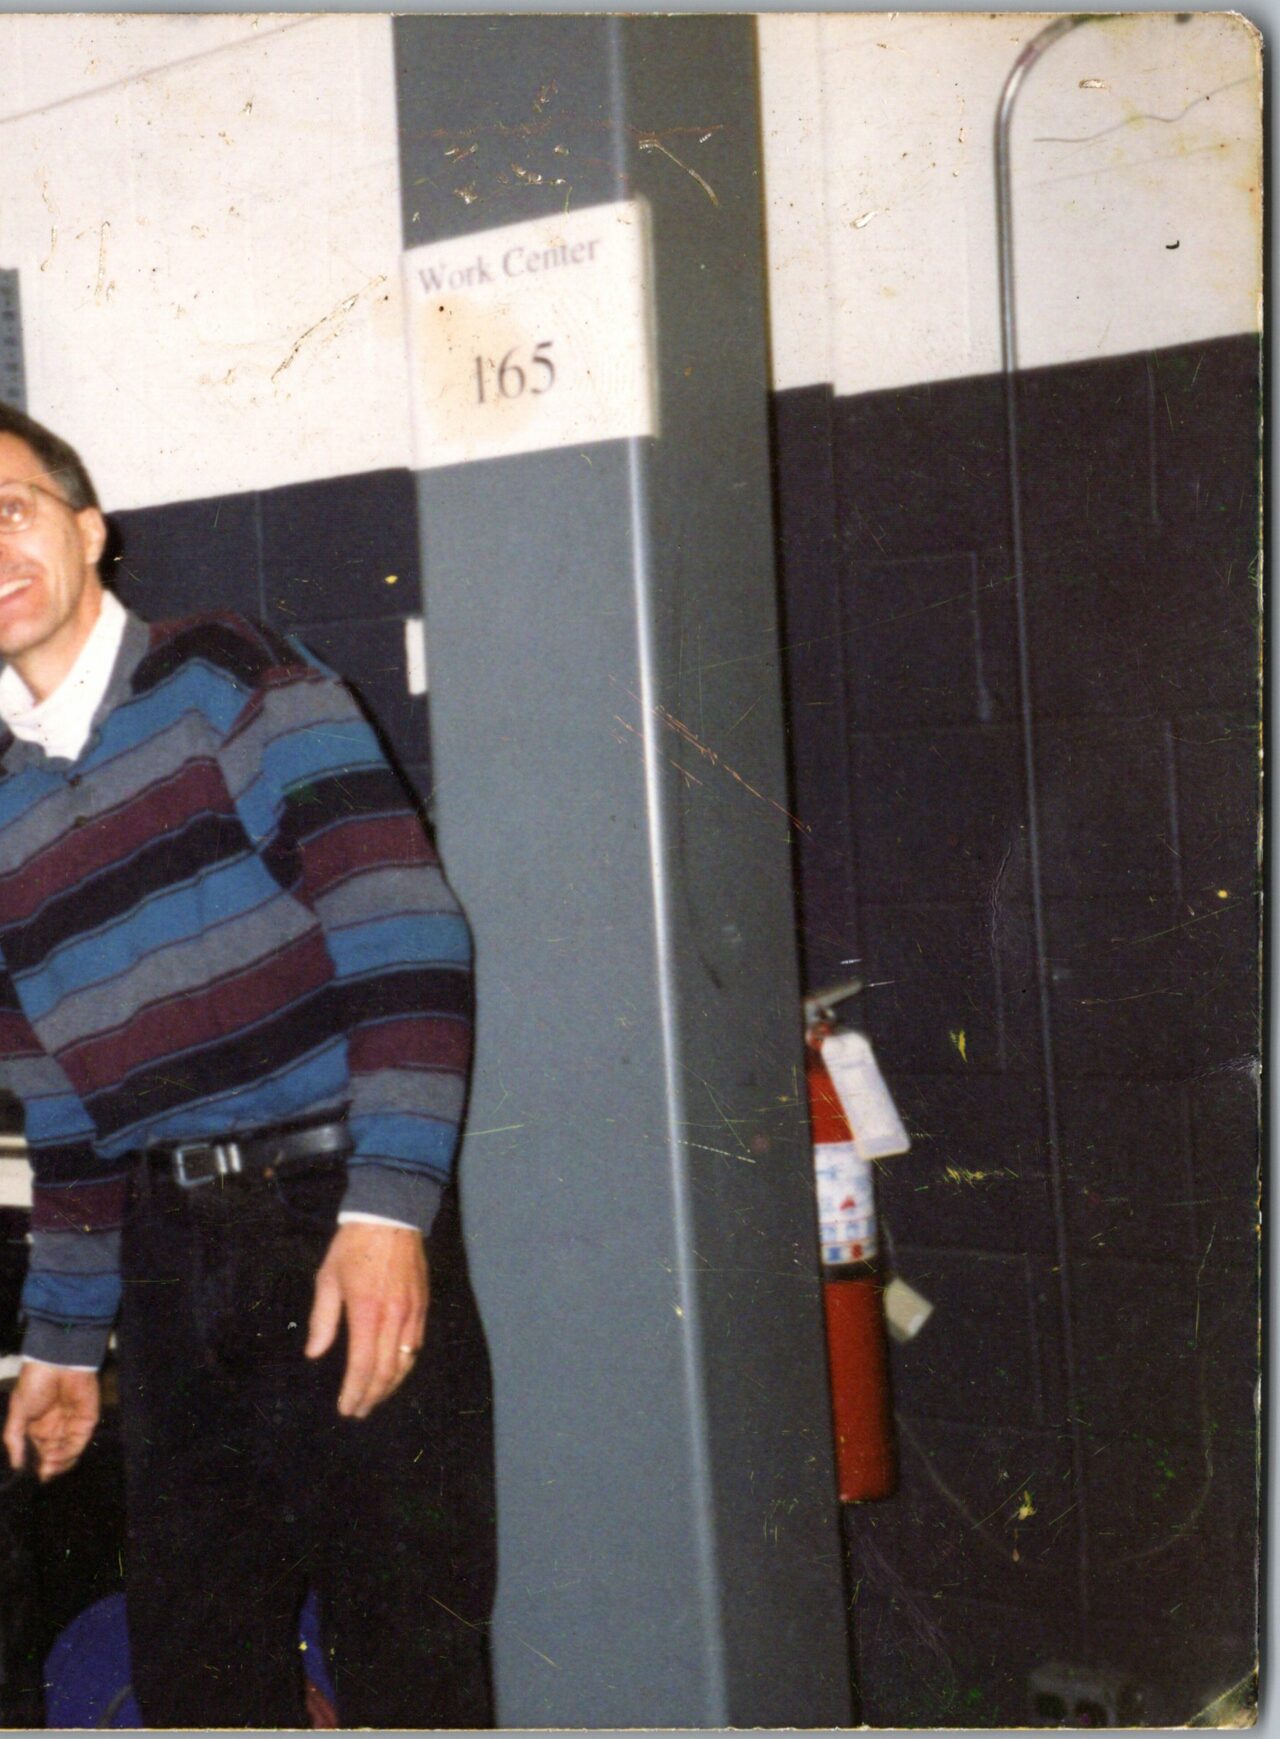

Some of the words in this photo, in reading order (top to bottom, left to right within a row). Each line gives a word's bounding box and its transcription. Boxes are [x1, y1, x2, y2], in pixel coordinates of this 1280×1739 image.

[418, 256, 493, 295] Work
[502, 237, 601, 278] Center
[475, 341, 556, 404] 165
